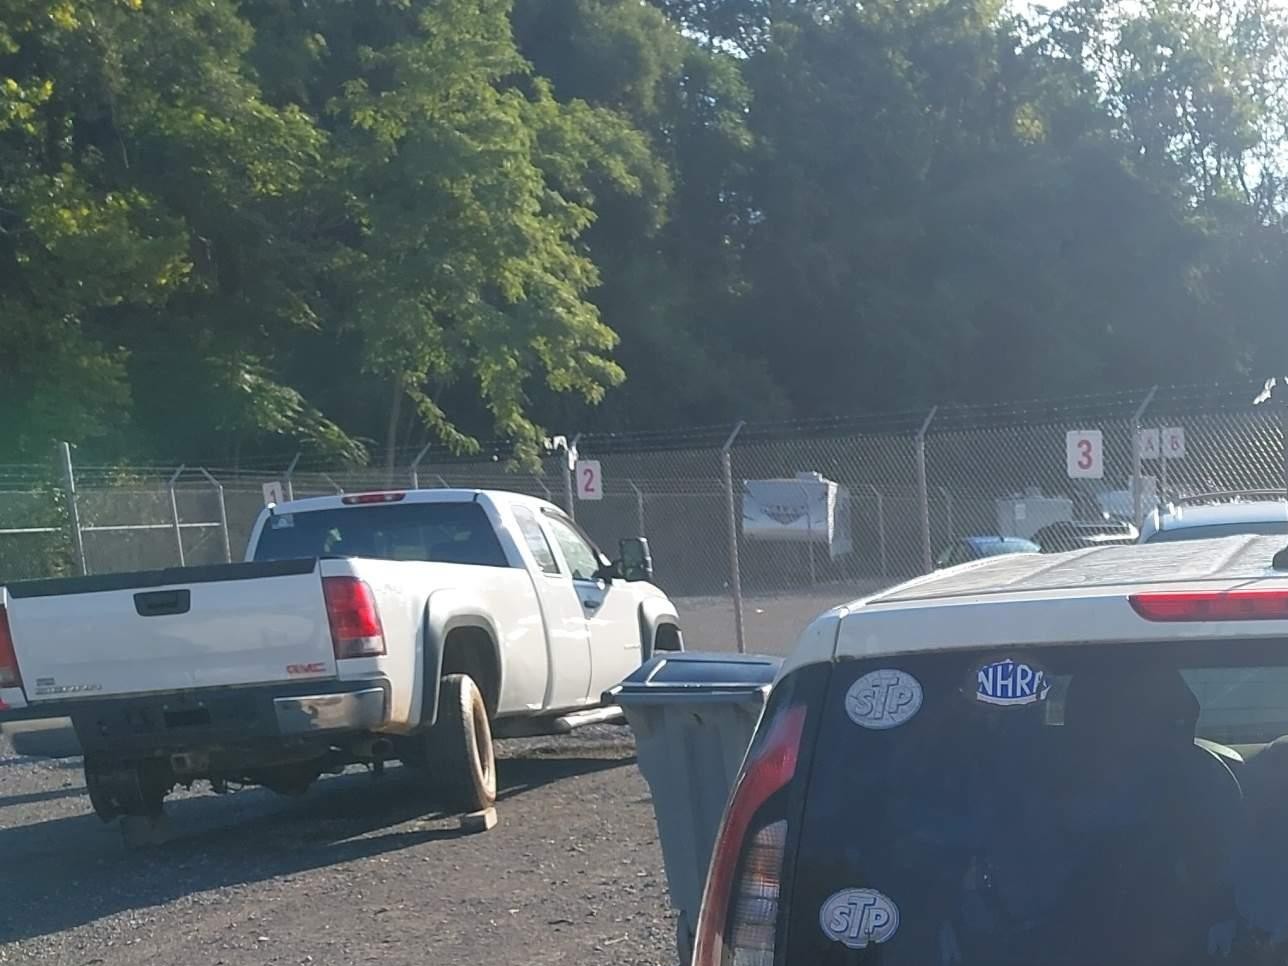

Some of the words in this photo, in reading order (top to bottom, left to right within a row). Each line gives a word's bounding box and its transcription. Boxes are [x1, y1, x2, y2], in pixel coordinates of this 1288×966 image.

[1077, 438, 1093, 470] 3
[583, 468, 595, 492] 2
[853, 676, 914, 720] STP
[829, 896, 890, 939] STP
